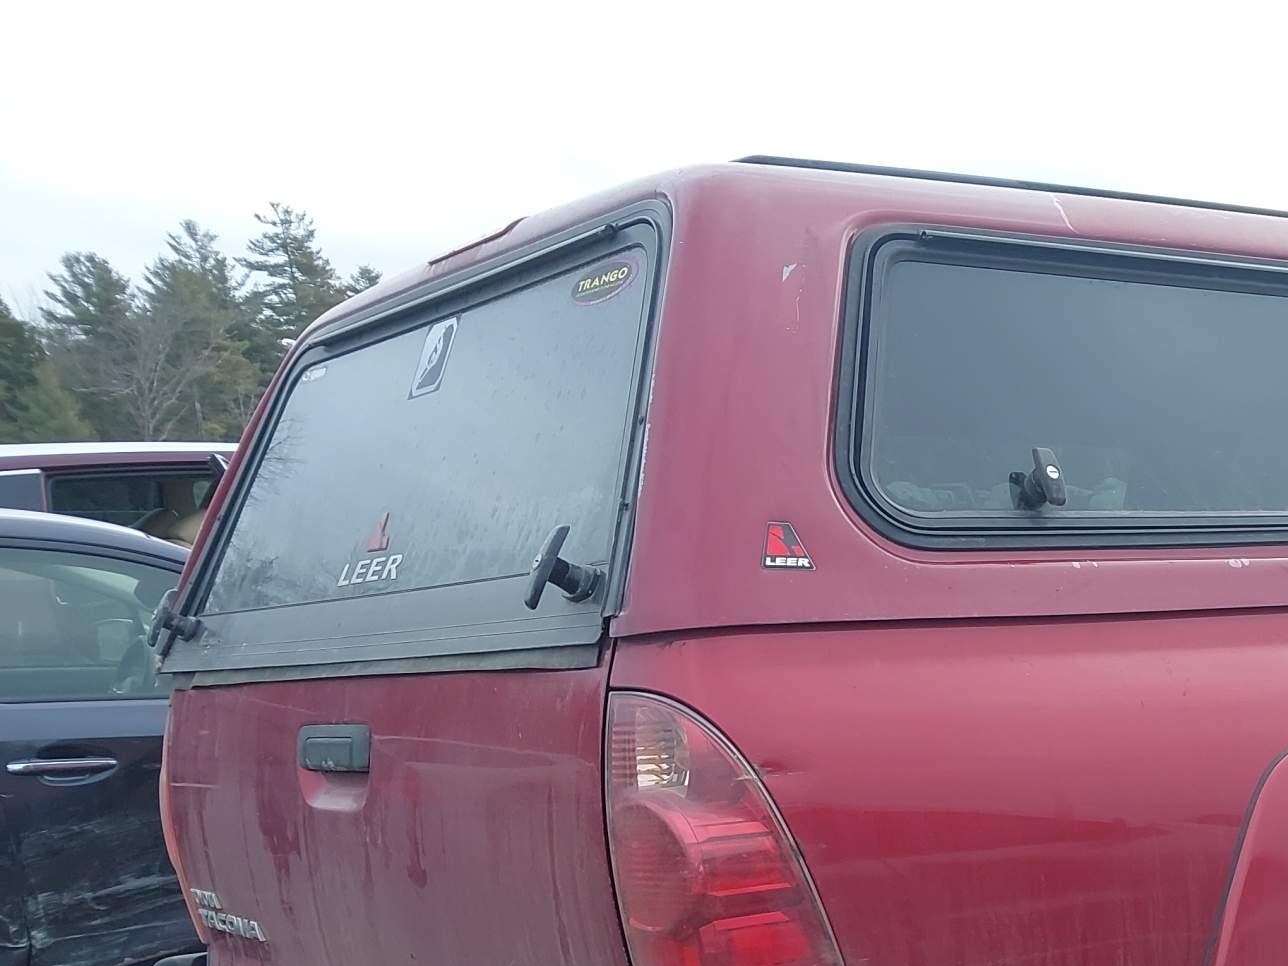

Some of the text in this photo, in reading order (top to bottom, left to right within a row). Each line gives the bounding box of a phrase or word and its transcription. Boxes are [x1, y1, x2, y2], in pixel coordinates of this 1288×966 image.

[578, 267, 629, 292] TRANGO
[337, 554, 403, 587] LEER
[765, 556, 811, 568] LEER
